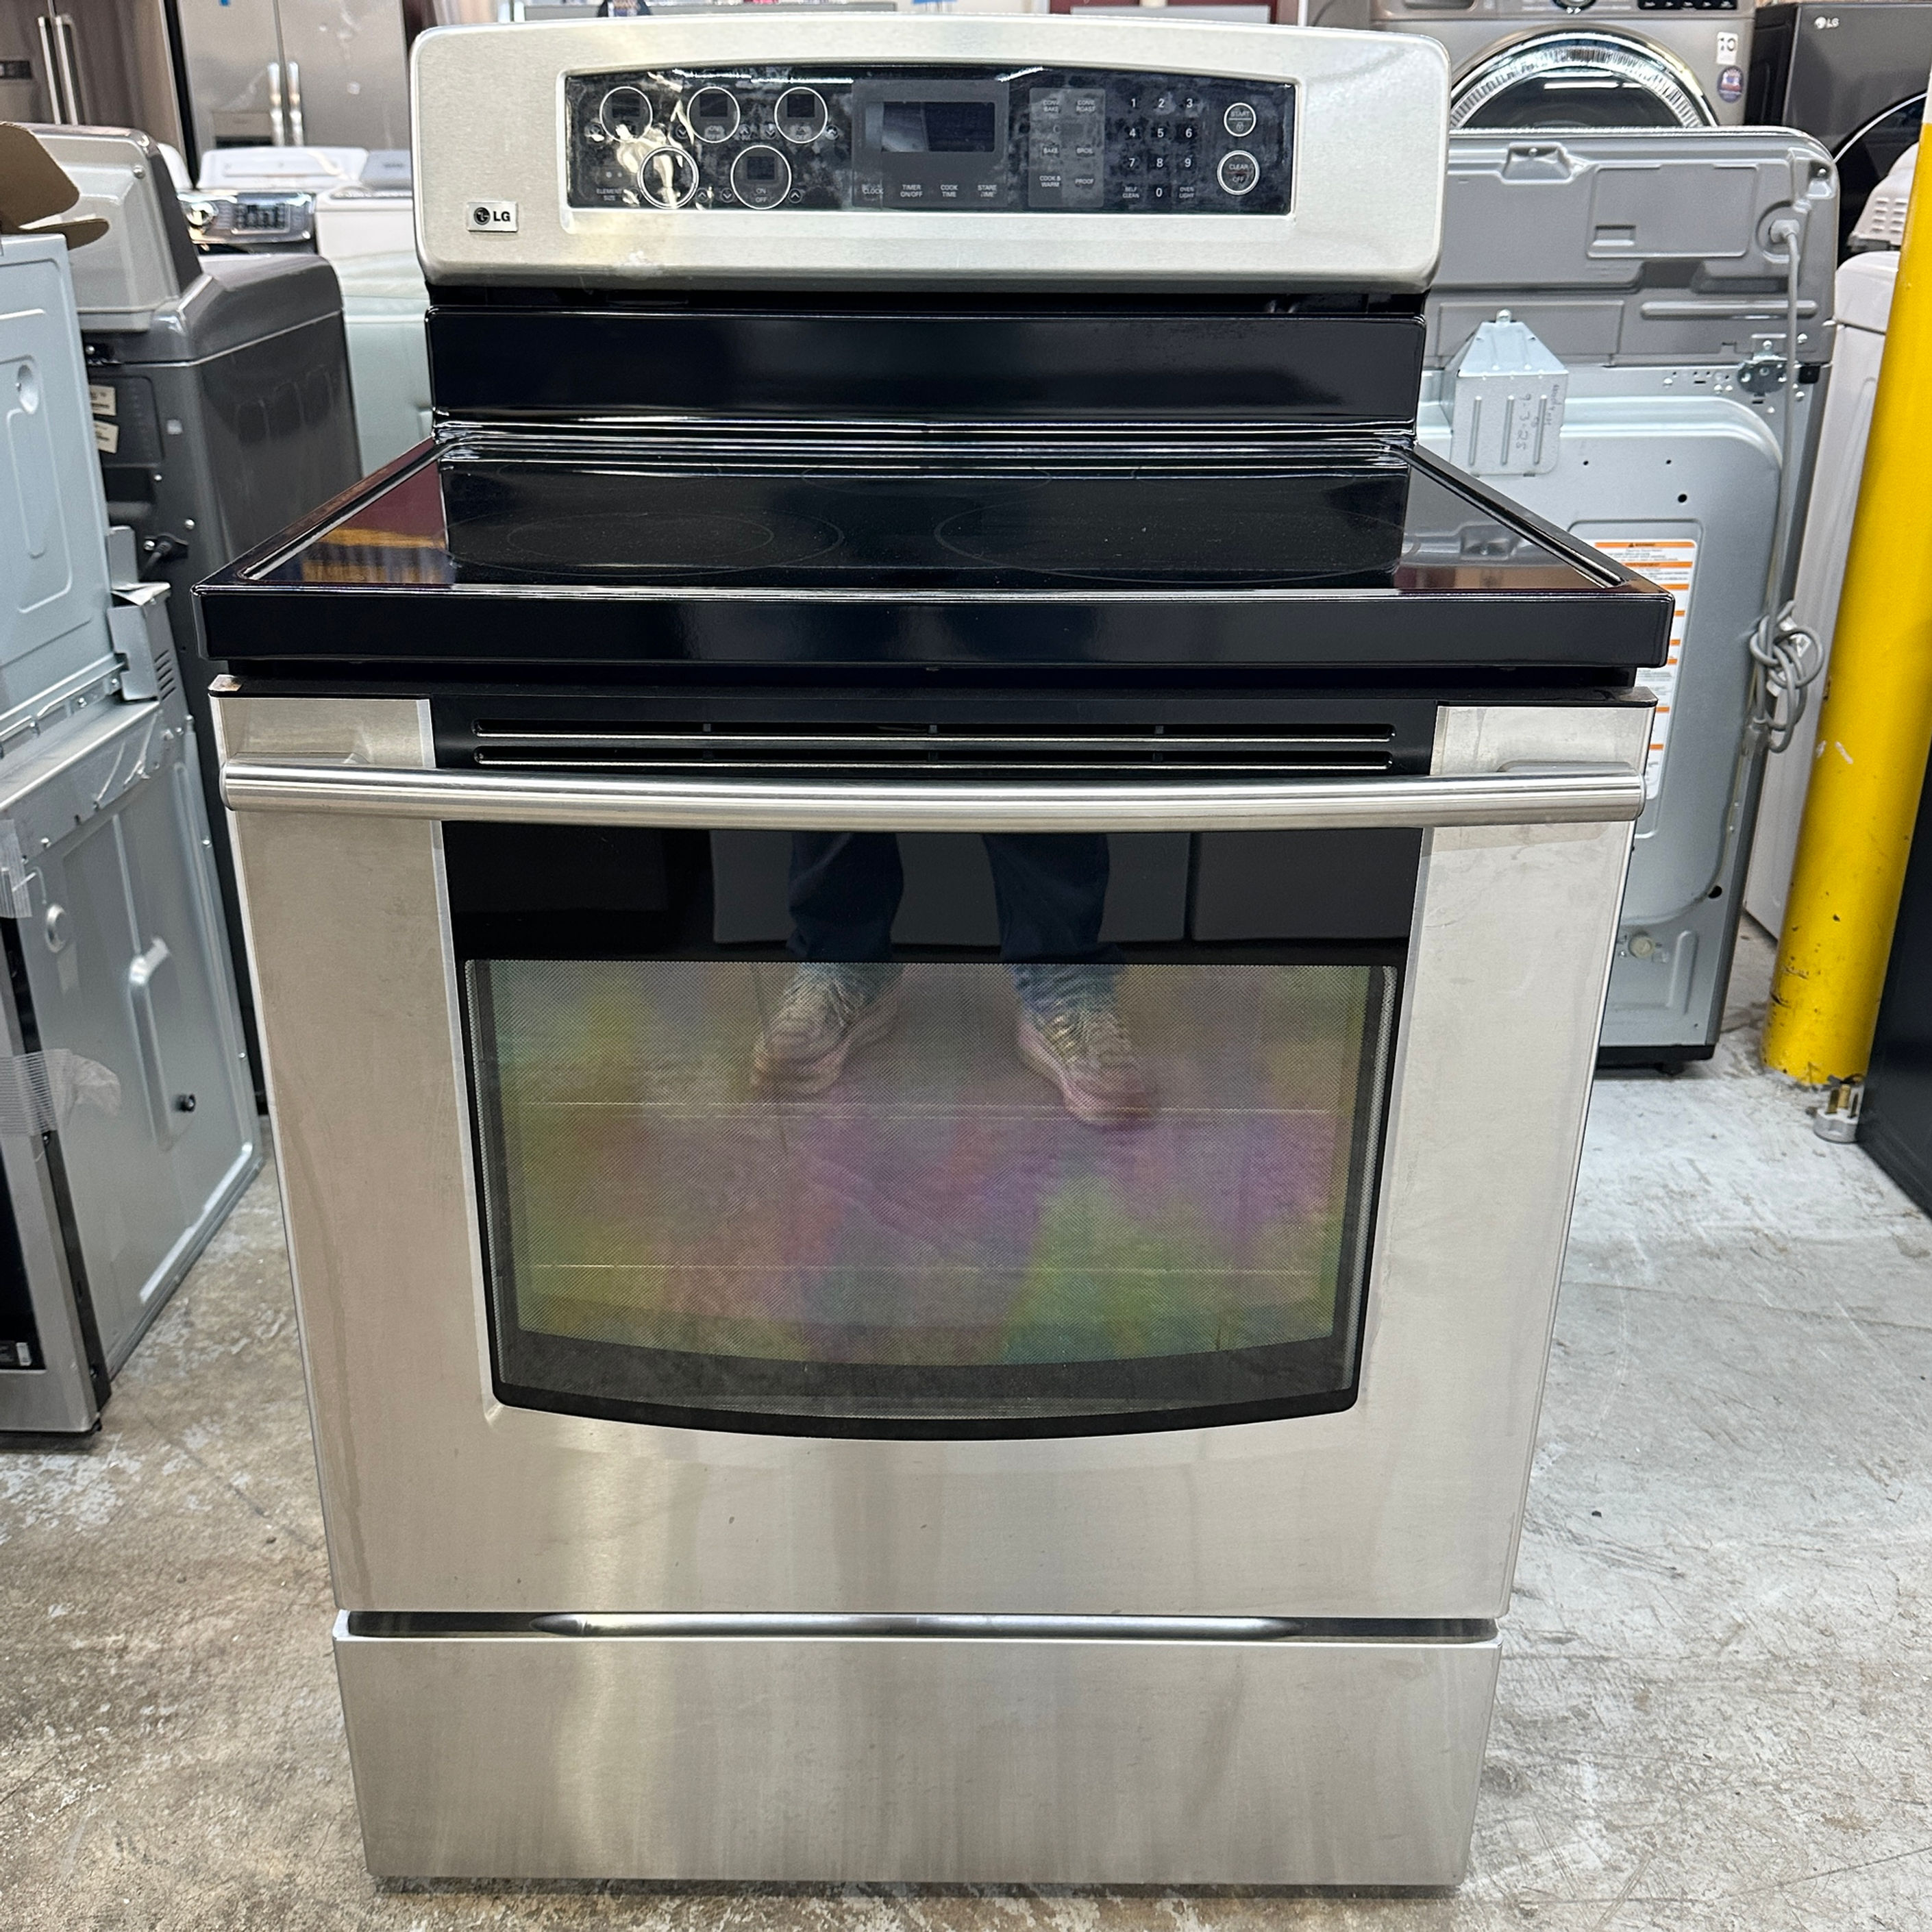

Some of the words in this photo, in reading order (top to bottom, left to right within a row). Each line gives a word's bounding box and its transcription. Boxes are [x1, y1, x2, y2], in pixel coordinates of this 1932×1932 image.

[1826, 18, 1840, 28] LG
[1130, 98, 1136, 108] 1
[1158, 98, 1165, 108] 2
[1186, 98, 1193, 108] 3
[1129, 127, 1137, 137] 4
[1157, 128, 1164, 138] 5
[1185, 128, 1193, 138] 6
[1128, 158, 1135, 167] 7
[1156, 158, 1163, 167] 8
[1184, 158, 1191, 167] 9
[1156, 187, 1163, 197] 0
[493, 210, 510, 222] LG
